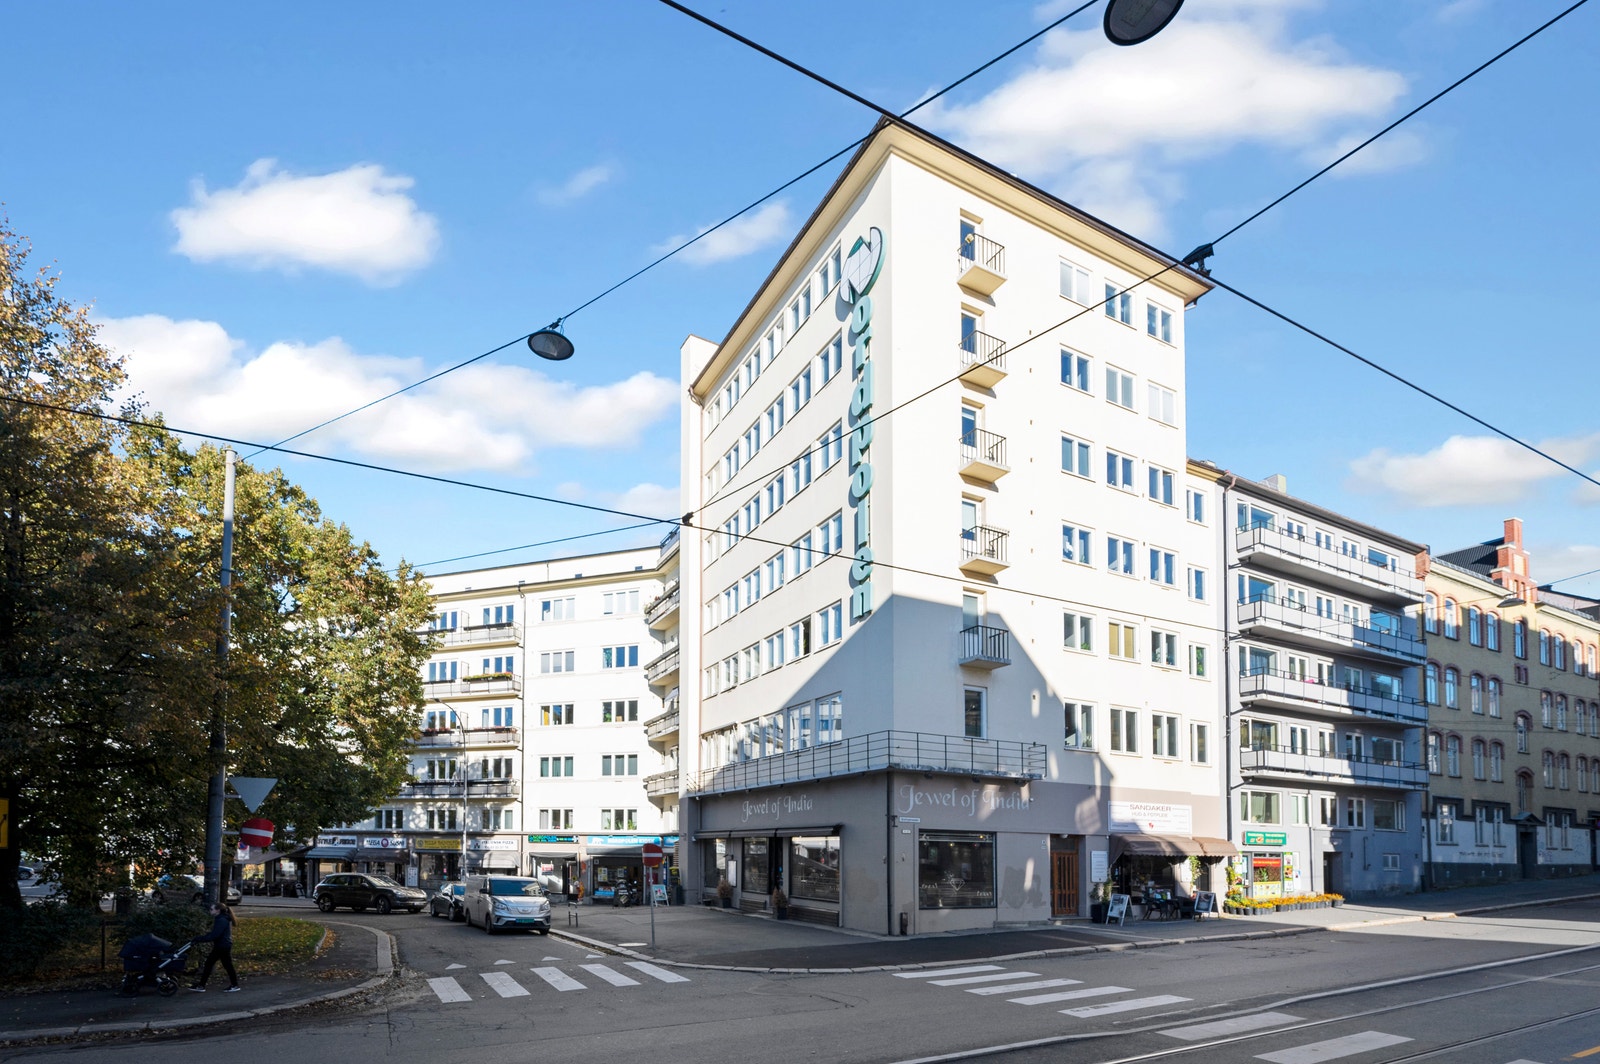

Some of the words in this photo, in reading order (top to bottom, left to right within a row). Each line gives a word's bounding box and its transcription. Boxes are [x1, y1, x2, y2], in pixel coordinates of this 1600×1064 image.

[742, 799, 769, 822] Jewel
[771, 796, 782, 820] of
[783, 794, 813, 814] India
[898, 784, 957, 814] Jewel
[960, 788, 979, 816] of
[982, 789, 1031, 811] India
[1129, 803, 1172, 812] SANDAKER
